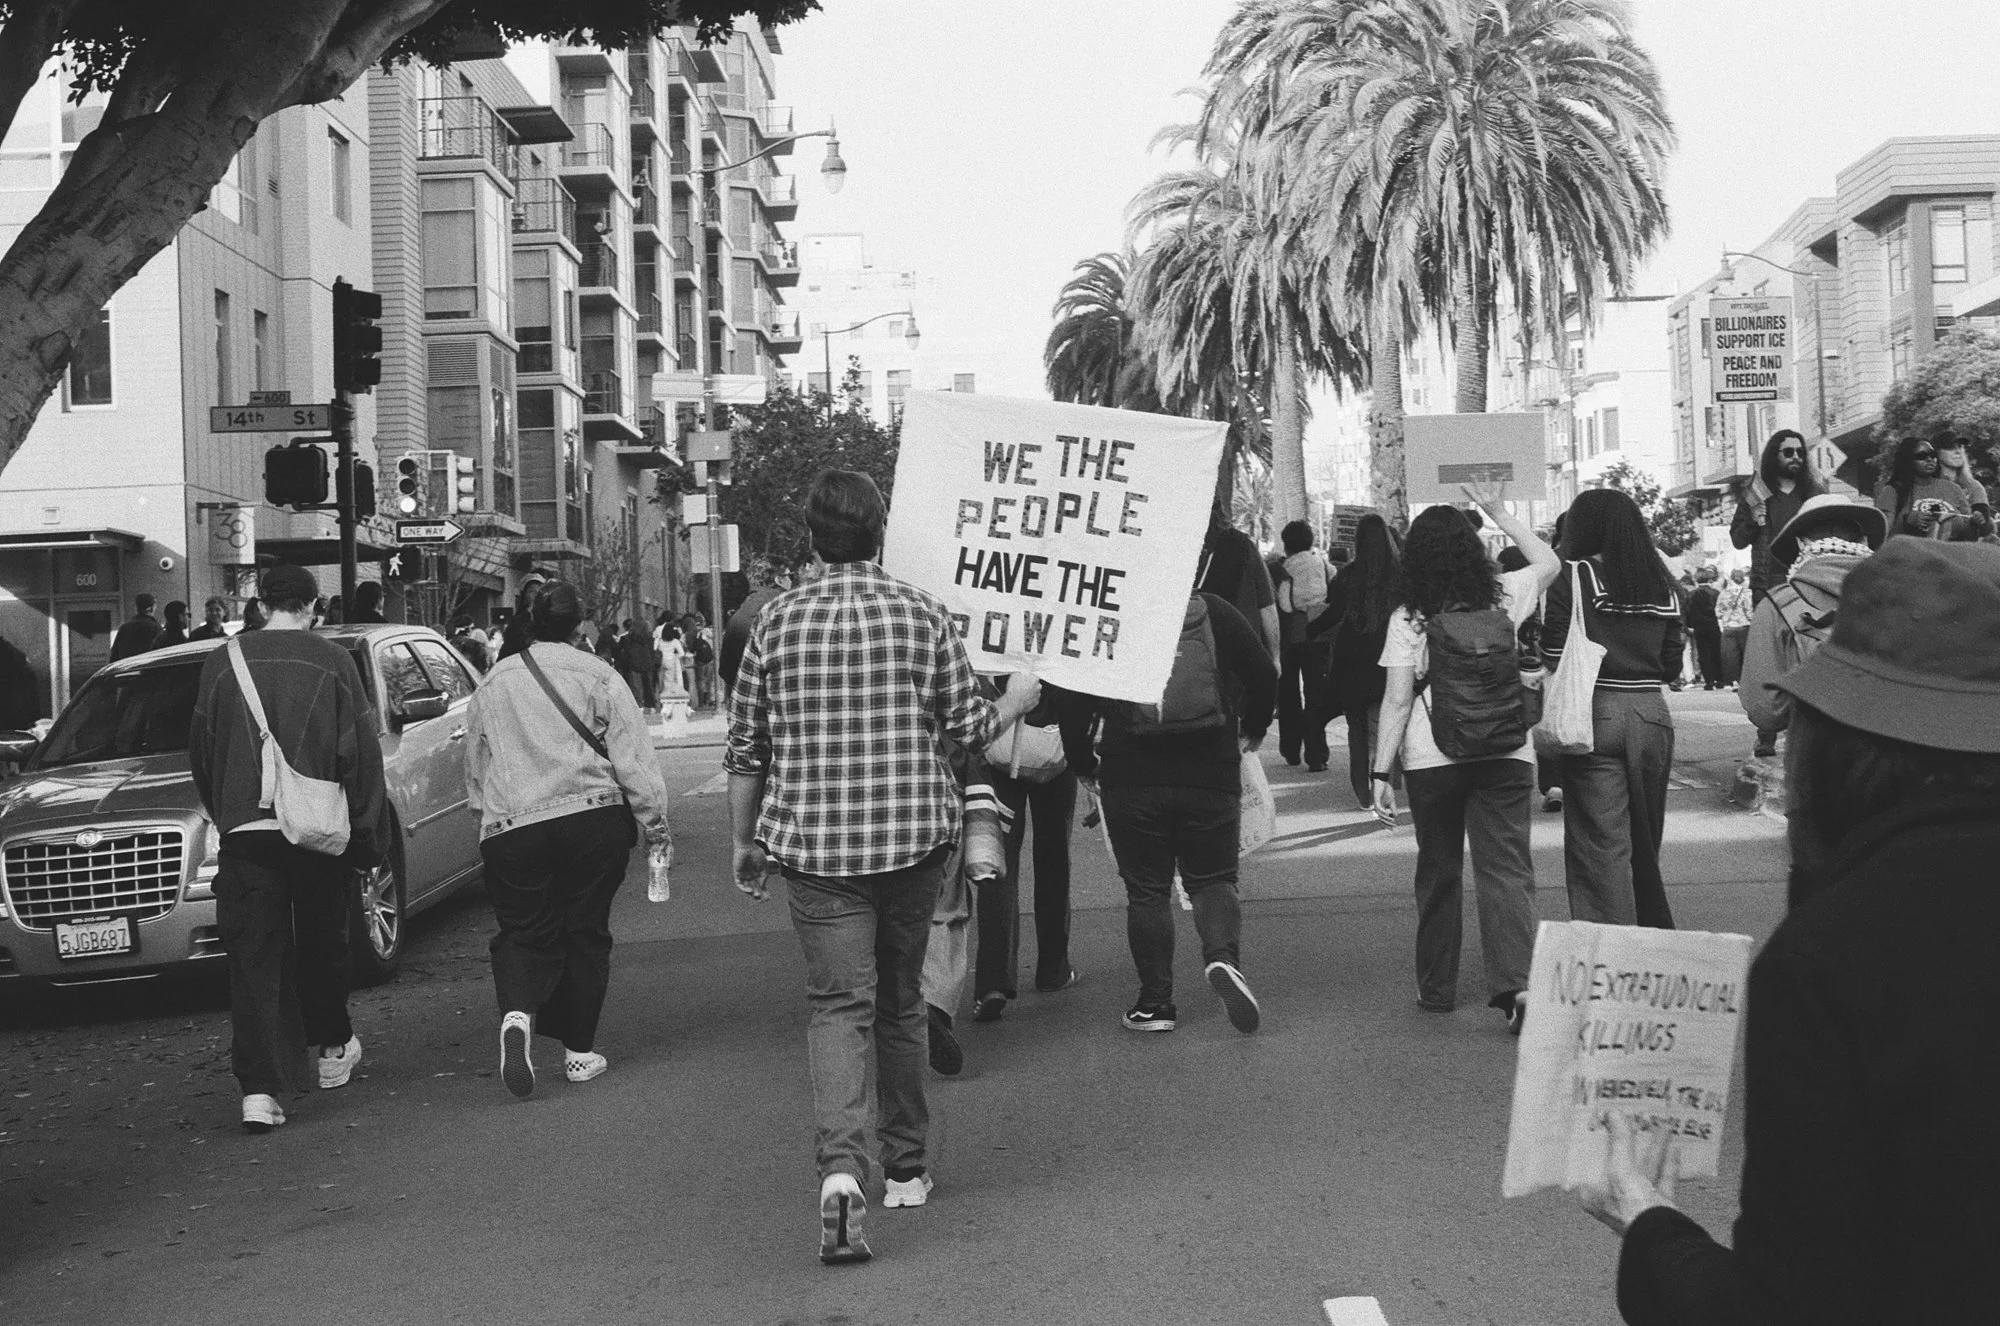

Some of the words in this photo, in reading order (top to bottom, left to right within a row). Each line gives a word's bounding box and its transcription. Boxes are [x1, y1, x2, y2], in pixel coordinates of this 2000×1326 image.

[1715, 315, 1787, 332] BILLIONAIRES
[1716, 333, 1765, 349] SUPPORT
[1768, 332, 1786, 348] ICE
[1723, 355, 1757, 371] PEACE
[1760, 355, 1782, 369] AND
[1725, 372, 1778, 389] FREEDOM
[264, 393, 286, 403] 600
[226, 411, 265, 427] 14th
[293, 410, 316, 426] St
[983, 440, 1042, 486] WE
[1055, 434, 1136, 484] THE
[954, 491, 1150, 540] PEOPLE
[403, 527, 422, 537] ONE
[425, 527, 444, 536] WAY
[76, 573, 97, 587] 600
[954, 546, 1049, 599] HAVE
[1056, 560, 1127, 612] THE
[60, 927, 127, 953] 5JGB687
